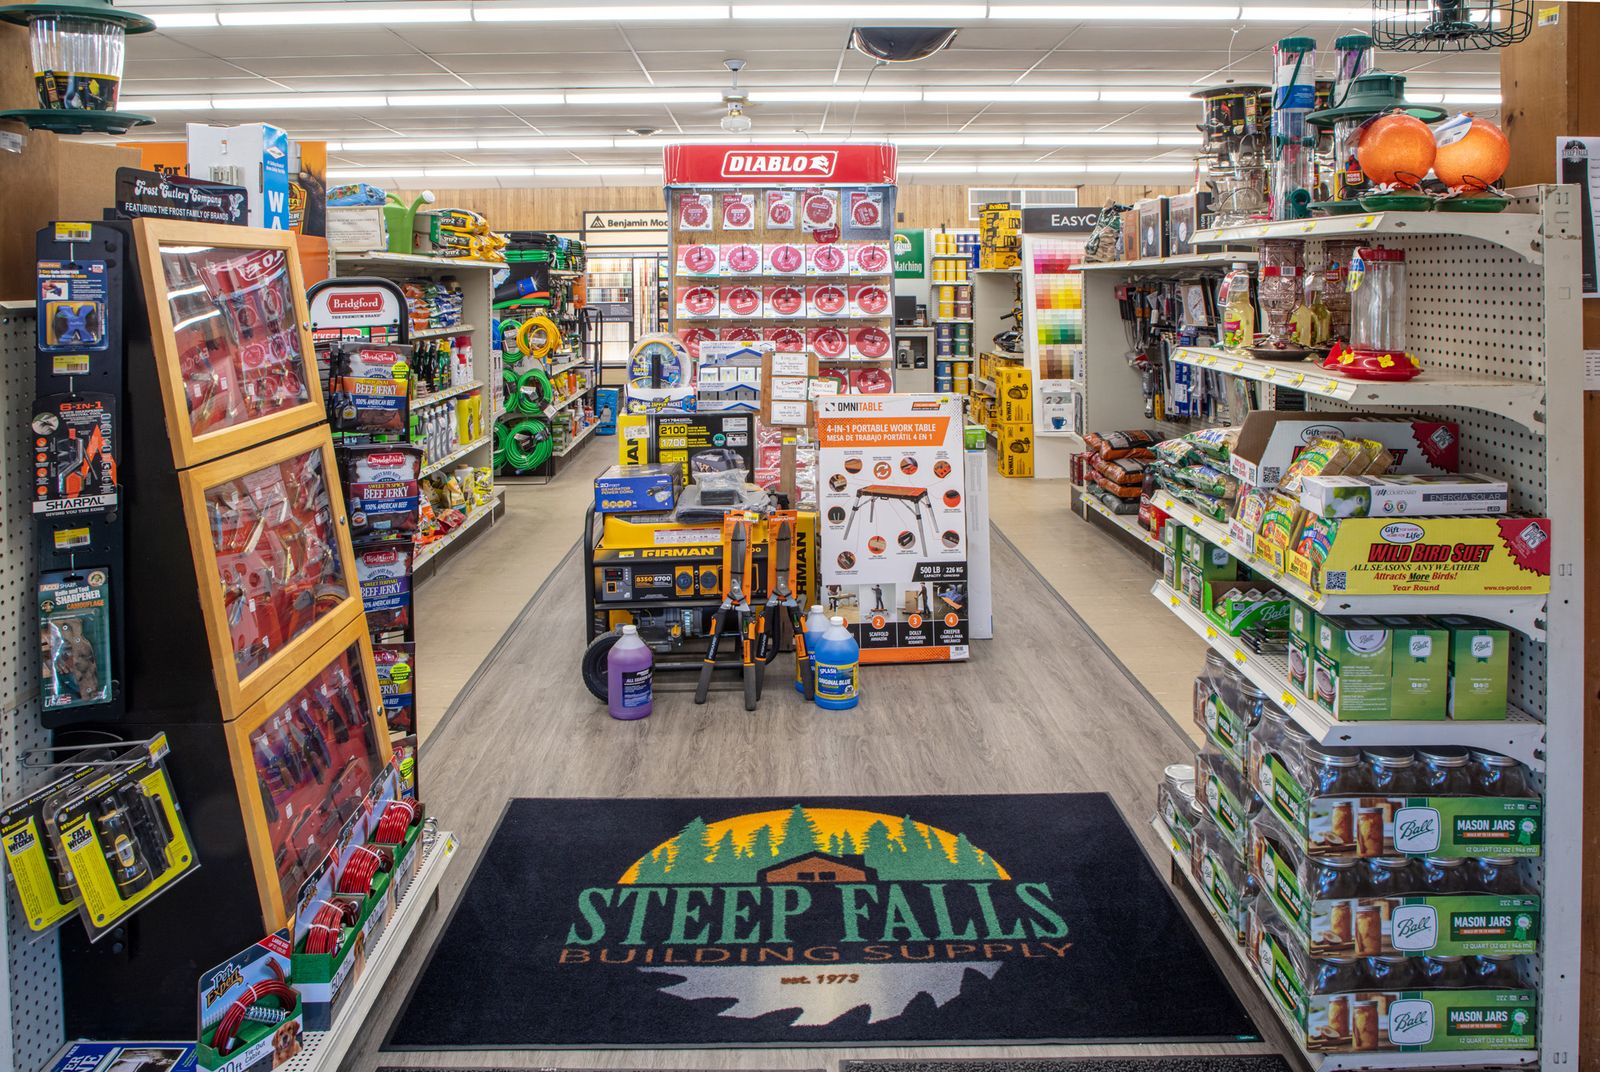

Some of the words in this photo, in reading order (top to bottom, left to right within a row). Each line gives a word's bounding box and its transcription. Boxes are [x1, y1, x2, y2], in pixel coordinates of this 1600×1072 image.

[729, 156, 808, 172] DIABLO
[125, 202, 157, 215] FEATURING
[157, 205, 168, 216] THE
[169, 206, 186, 217] FROST
[186, 208, 204, 219] FAMILY
[204, 210, 211, 219] OF
[210, 211, 229, 221] BRANDS
[607, 219, 648, 229] Benjamin
[333, 298, 379, 310] Bridgford
[355, 383, 374, 395] BEEF
[374, 384, 398, 395] JERKY
[60, 401, 103, 411] 6-IN-1
[837, 402, 883, 411] OMNITABLE
[661, 426, 686, 435] 2100
[826, 424, 850, 433] 4-IN-1
[851, 424, 889, 433] PORTABLE
[889, 423, 913, 432] WORK
[914, 423, 936, 432] TABLE
[661, 439, 687, 447] 1700
[855, 434, 882, 442] TRABAJO
[929, 433, 933, 441] 1
[364, 488, 384, 500] BEEF
[384, 486, 409, 498] JERKY
[1430, 493, 1468, 501] ENERGÍA
[1471, 493, 1501, 501] SOLAR
[46, 496, 101, 510] SHARPAL
[642, 547, 715, 558] FIRMAN
[1368, 543, 1411, 563] WILD
[1411, 543, 1452, 563] BIRD
[1451, 543, 1494, 562] SUET
[920, 566, 932, 574] 500
[933, 566, 941, 574] LB
[1373, 572, 1407, 581] Attracts
[1408, 572, 1430, 581] More
[1431, 572, 1458, 581] Birds!
[361, 585, 380, 597] BEEF
[380, 582, 401, 595] JERKY
[1392, 584, 1411, 592] Year
[1413, 584, 1440, 592] Round
[55, 590, 101, 606] SHARPENER
[371, 598, 391, 607] AMERICAN
[1260, 604, 1290, 621] Ball
[876, 618, 882, 626] 2
[912, 617, 918, 625] 3
[949, 616, 954, 624] 4
[1360, 634, 1375, 644] Ball
[1412, 639, 1430, 651] Ball
[1474, 640, 1491, 652] Ball
[381, 684, 400, 694] ERKY
[1399, 818, 1434, 840] Ball
[1457, 820, 1490, 831] MASON
[1491, 820, 1516, 831] JARS
[13, 829, 28, 843] FAT
[71, 826, 86, 841] FAT
[564, 884, 813, 945] STEEP
[835, 881, 1070, 943] FALLS
[1397, 915, 1432, 938] Ball
[1454, 916, 1486, 927] MASON
[1488, 915, 1512, 927] JARS
[558, 946, 839, 964] BUILDING
[863, 942, 1074, 961] SUPPLY
[213, 963, 234, 989] Pet
[780, 975, 811, 985] est.
[816, 973, 860, 984] 1973
[206, 965, 244, 1009] Expert
[1394, 1010, 1429, 1033] Ball
[1451, 1011, 1483, 1022] MASON
[1485, 1010, 1508, 1022] JARS
